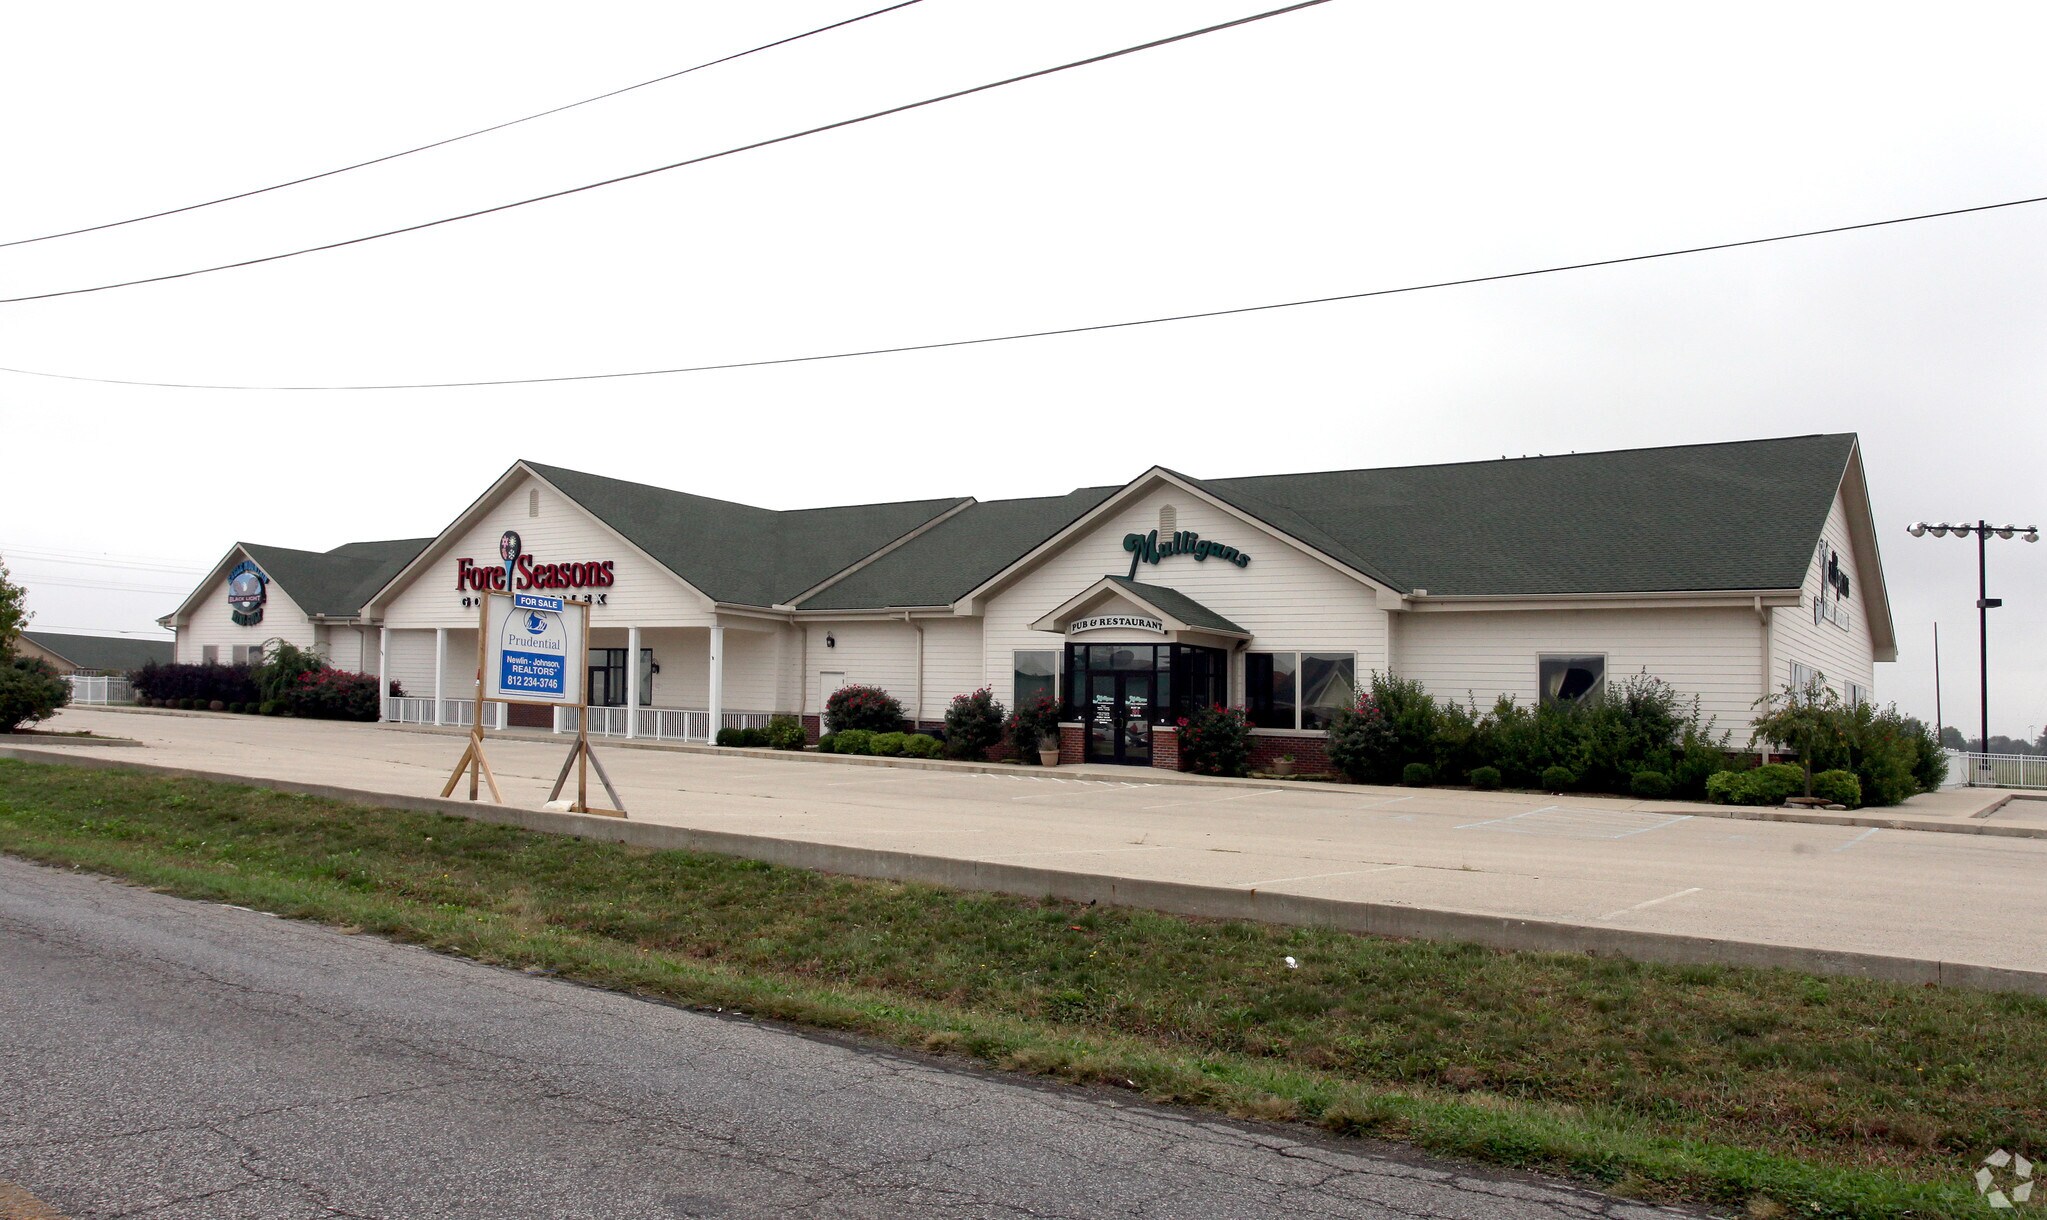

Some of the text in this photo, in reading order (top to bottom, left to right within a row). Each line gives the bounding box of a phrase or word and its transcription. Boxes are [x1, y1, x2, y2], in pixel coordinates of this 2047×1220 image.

[1122, 529, 1251, 579] Mulligans
[455, 554, 615, 592] Fore Seasons
[520, 597, 537, 606] FOR
[538, 600, 558, 609] SALE
[1072, 617, 1163, 631] PUB & RESTAURANT
[508, 633, 561, 650] Prudential
[506, 655, 529, 665] Newlin
[507, 675, 558, 689] 812 234-3746
